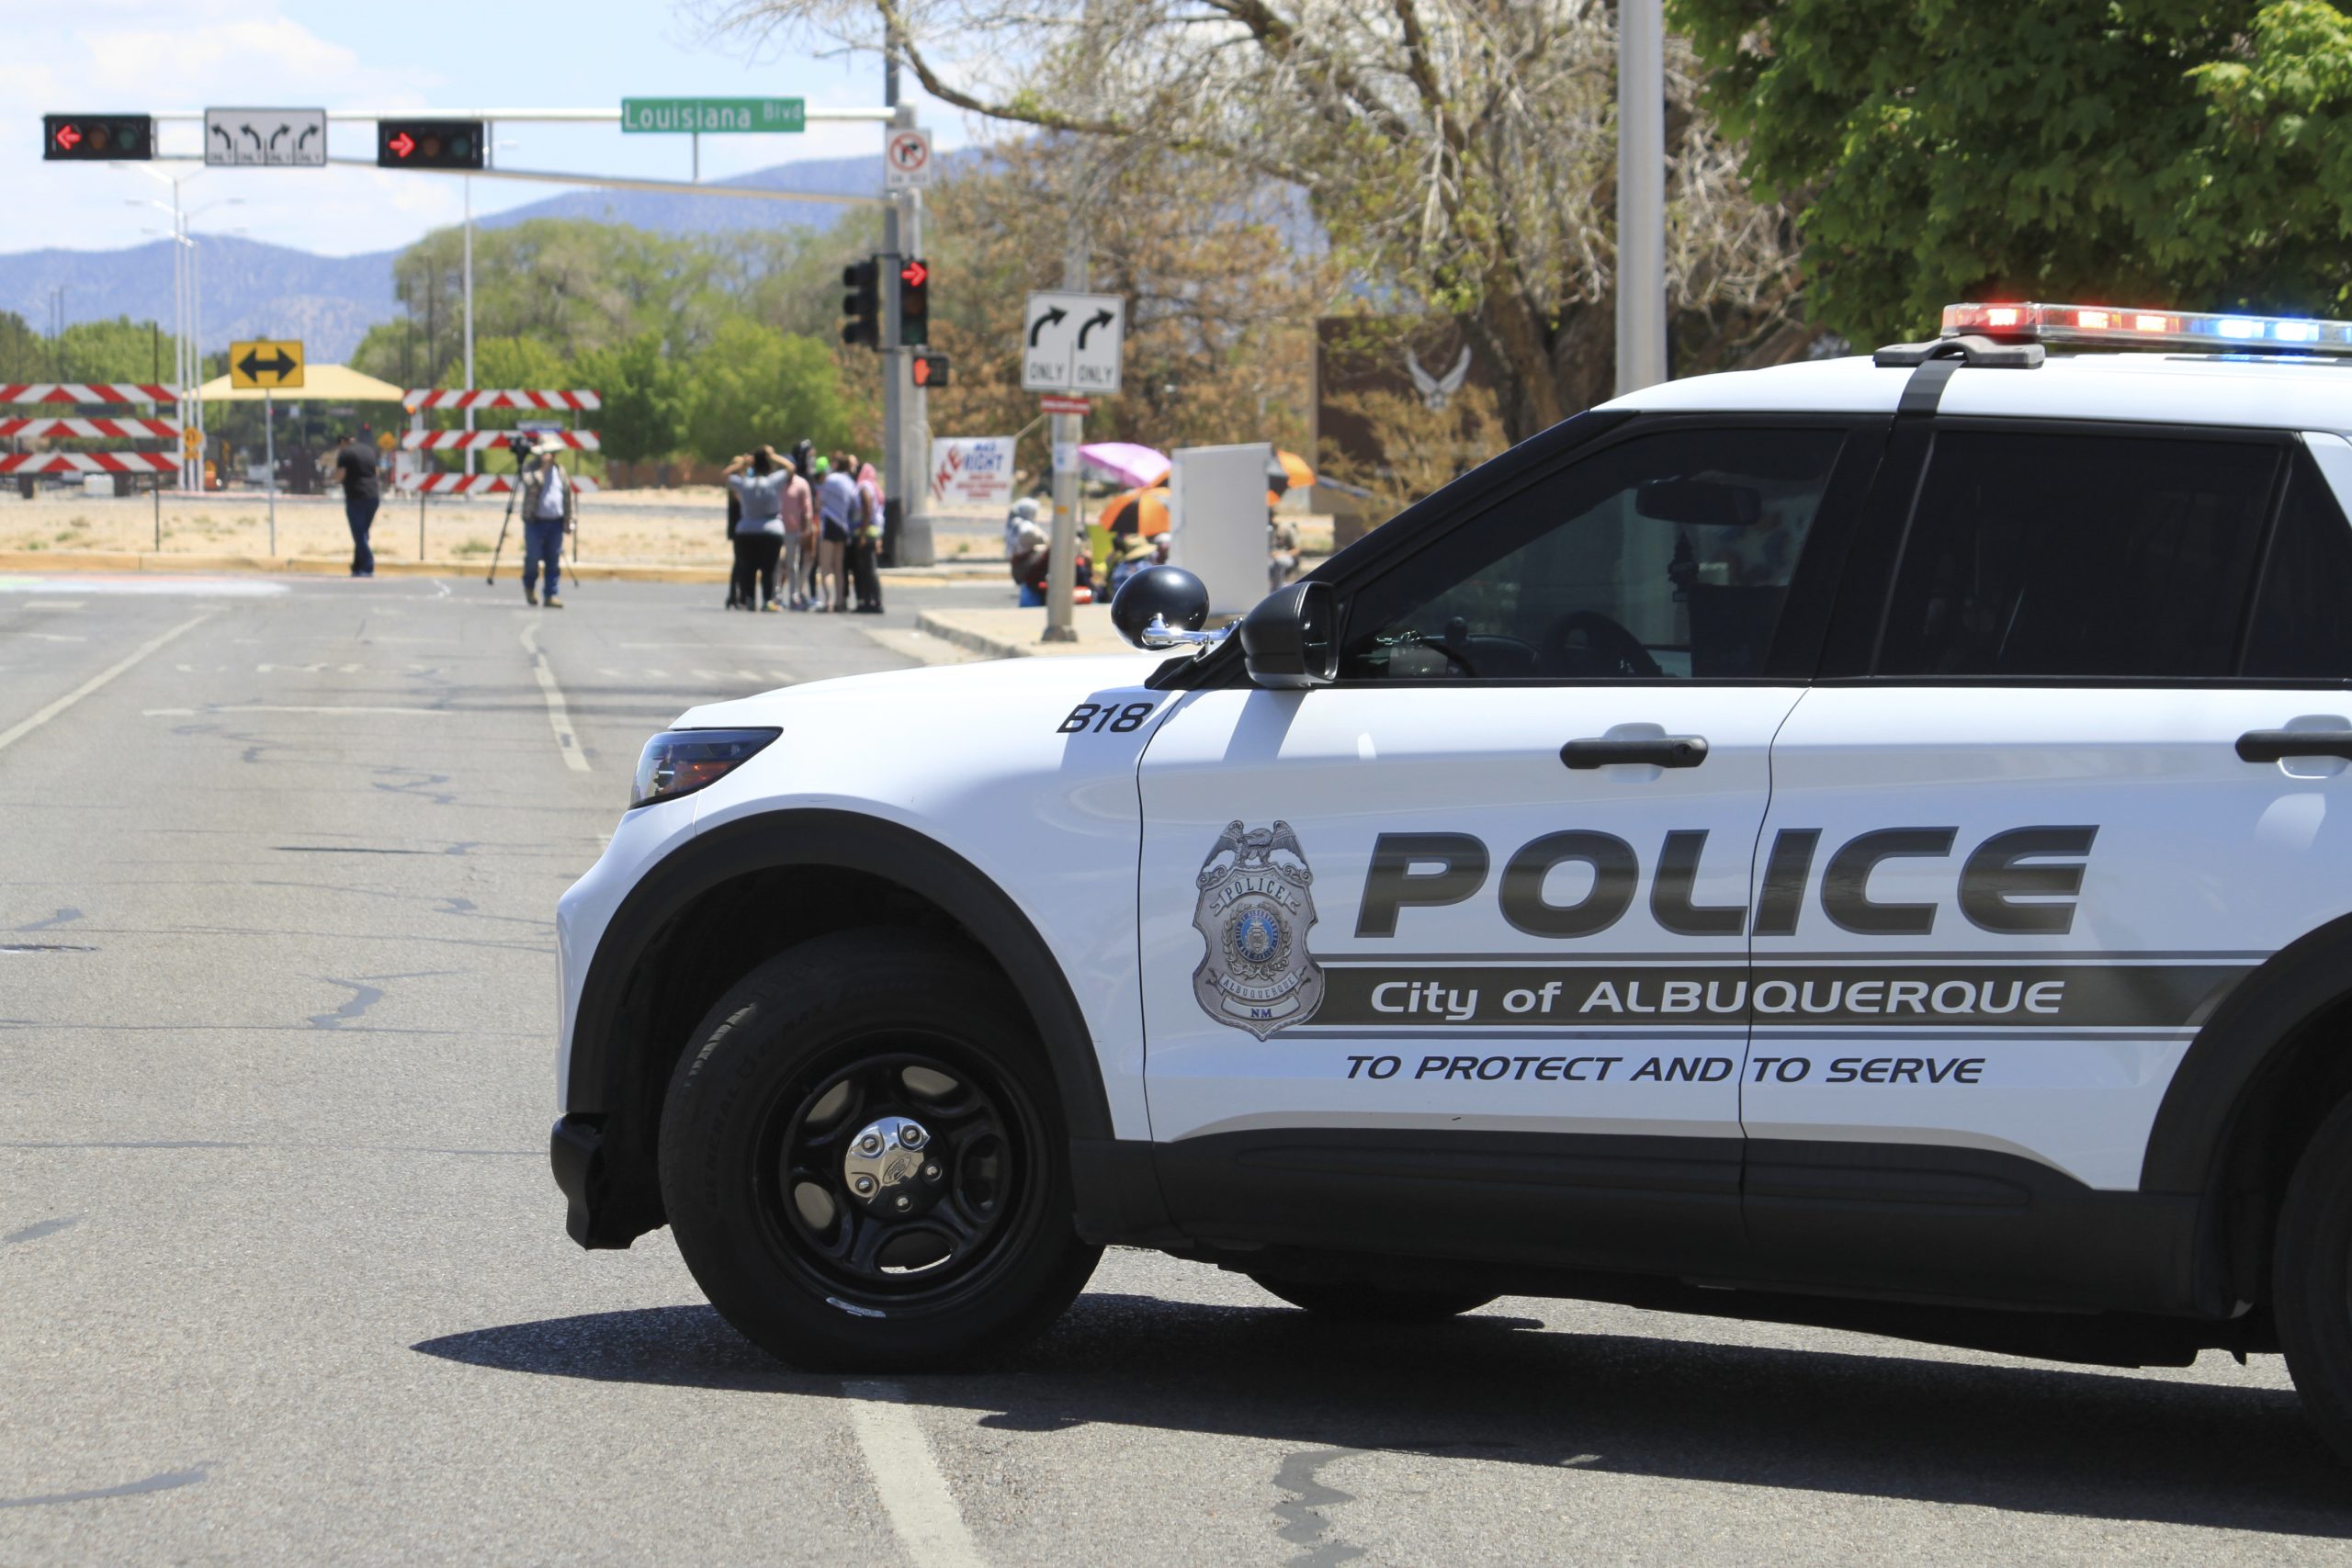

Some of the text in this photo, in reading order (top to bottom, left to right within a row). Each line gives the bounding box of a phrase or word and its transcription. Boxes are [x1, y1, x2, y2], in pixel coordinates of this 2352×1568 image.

[623, 102, 804, 130] Louisiana Blvd
[1029, 362, 1065, 381] ONLY
[1077, 365, 1114, 384] ONLY
[1056, 703, 1154, 733] B18
[1225, 877, 1284, 900] POLICE
[1354, 825, 2100, 939] POLICE
[1223, 976, 1295, 999] ALBUQUERQUE
[1250, 1008, 1272, 1018] NM
[1371, 980, 2065, 1021] City of ALBUQUERQUE
[1346, 1055, 1985, 1084] TO PROTECT AND TO SERVE
